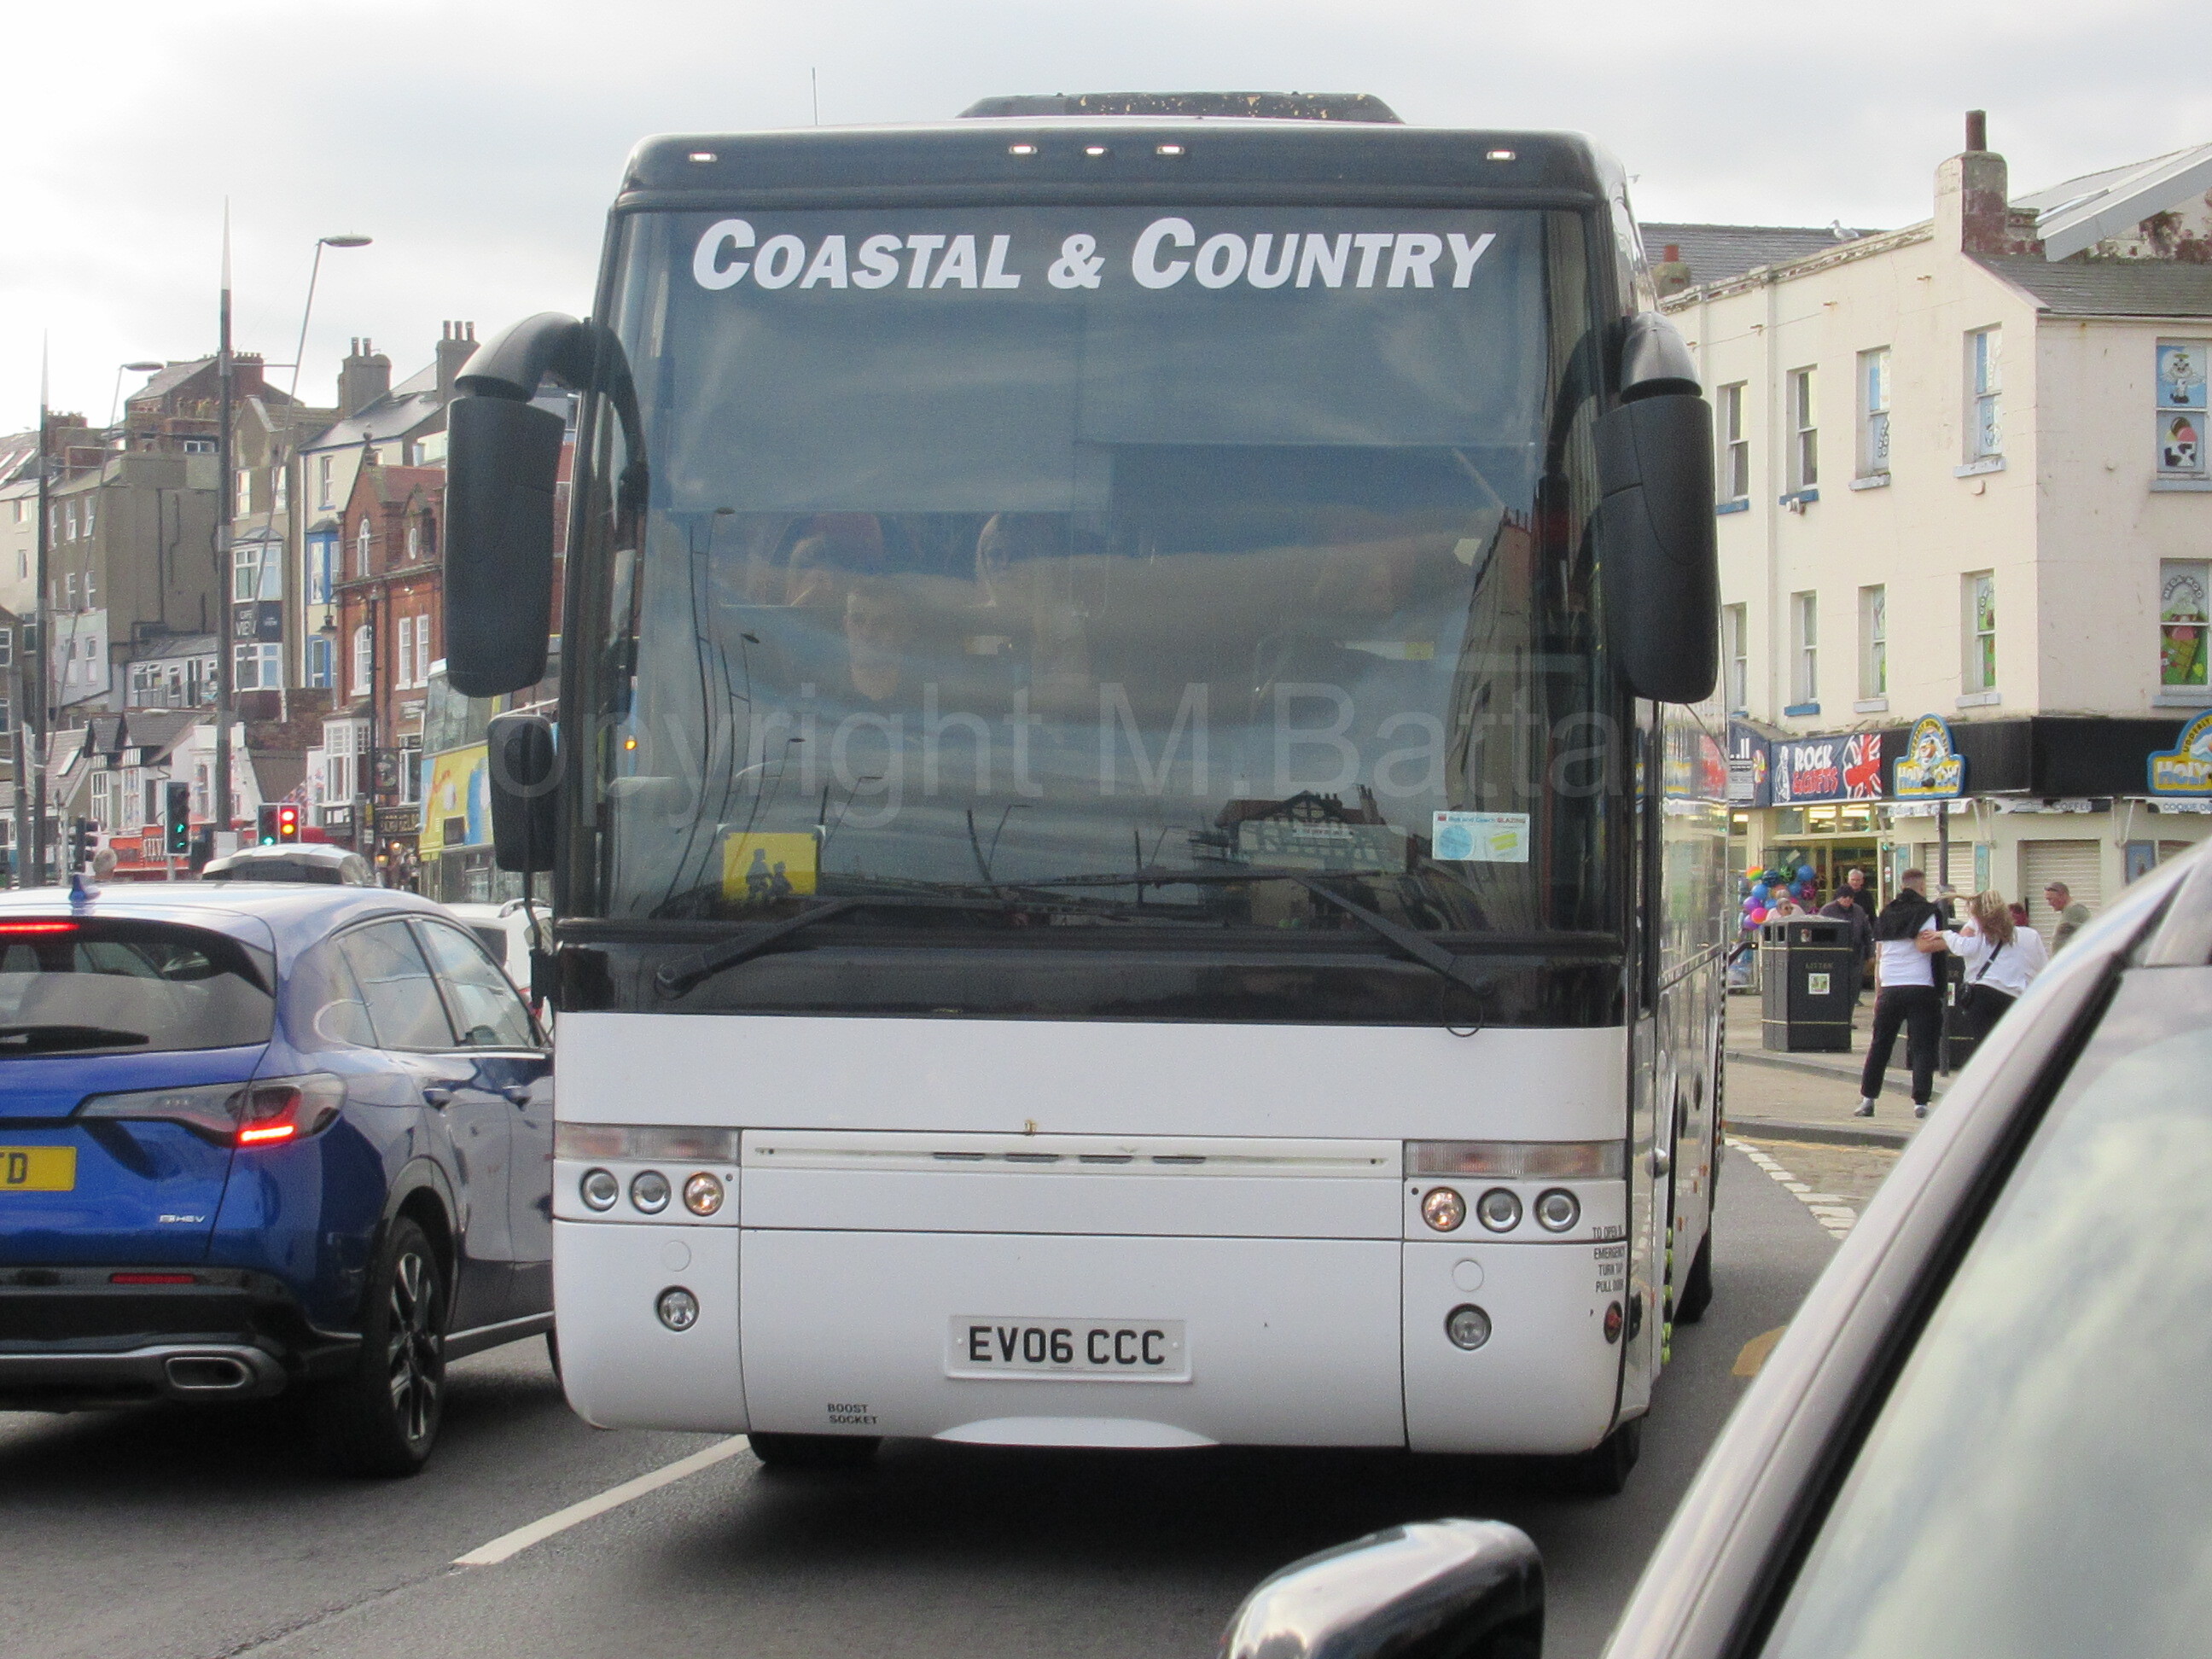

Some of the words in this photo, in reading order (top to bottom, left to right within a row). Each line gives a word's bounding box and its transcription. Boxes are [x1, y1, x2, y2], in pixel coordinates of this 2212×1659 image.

[692, 219, 1022, 291] COASTAL
[1047, 233, 1106, 289] &
[1132, 218, 1497, 290] COUNTRY
[1795, 743, 1834, 771] ROCK
[0, 1152, 28, 1185] D
[969, 1325, 1074, 1364] EV06
[1087, 1329, 1165, 1365] CCC
[827, 1403, 868, 1413] BOOST
[830, 1414, 878, 1424] SOCKET
